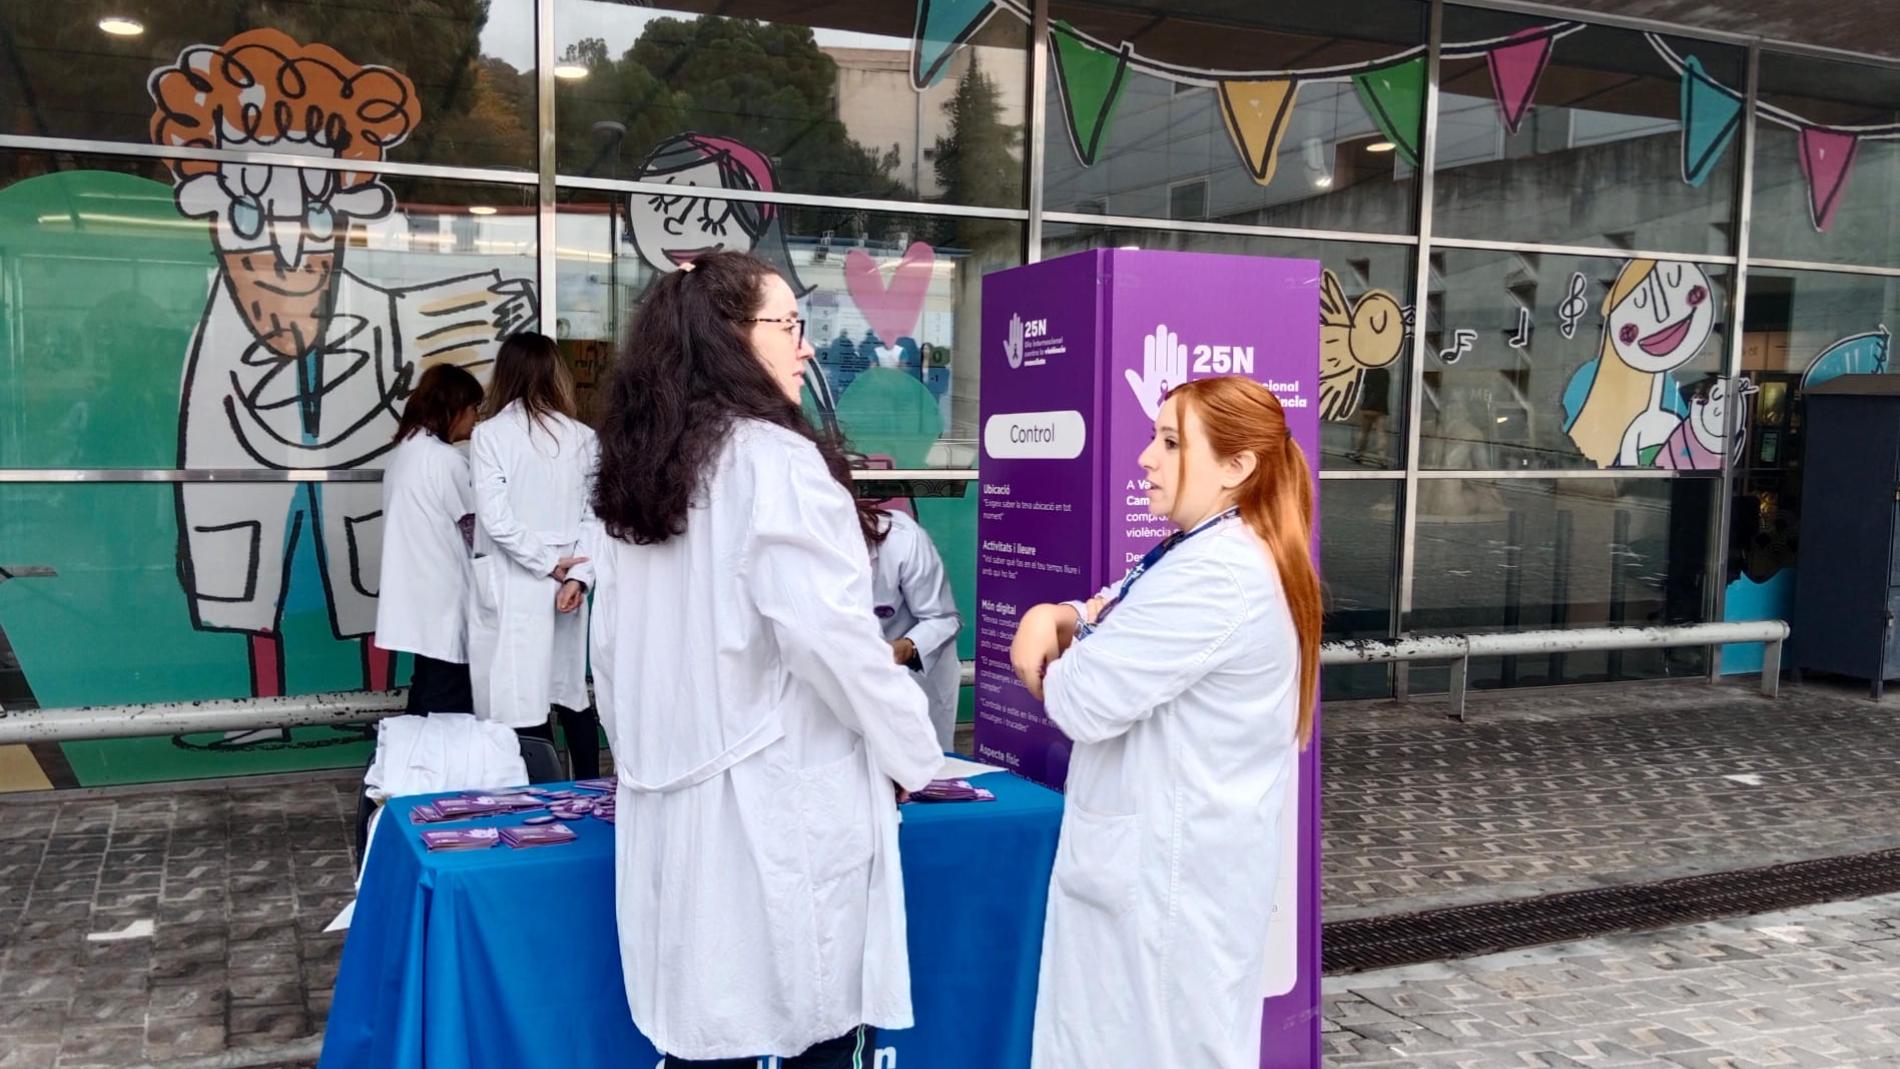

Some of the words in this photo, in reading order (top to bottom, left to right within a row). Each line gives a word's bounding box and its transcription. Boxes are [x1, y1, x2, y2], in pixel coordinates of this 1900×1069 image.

[1025, 319, 1047, 338] 25N
[1193, 345, 1254, 374] 25N
[1275, 394, 1308, 408] ncia
[1010, 423, 1055, 444] Control
[983, 484, 1011, 495] Ubicació
[1126, 480, 1136, 490] A
[1137, 480, 1152, 490] Va
[1126, 495, 1150, 506] Cam
[983, 540, 1013, 553] Activitats
[1017, 543, 1037, 556] lleure
[981, 599, 995, 612] Món
[995, 601, 1017, 616] digital
